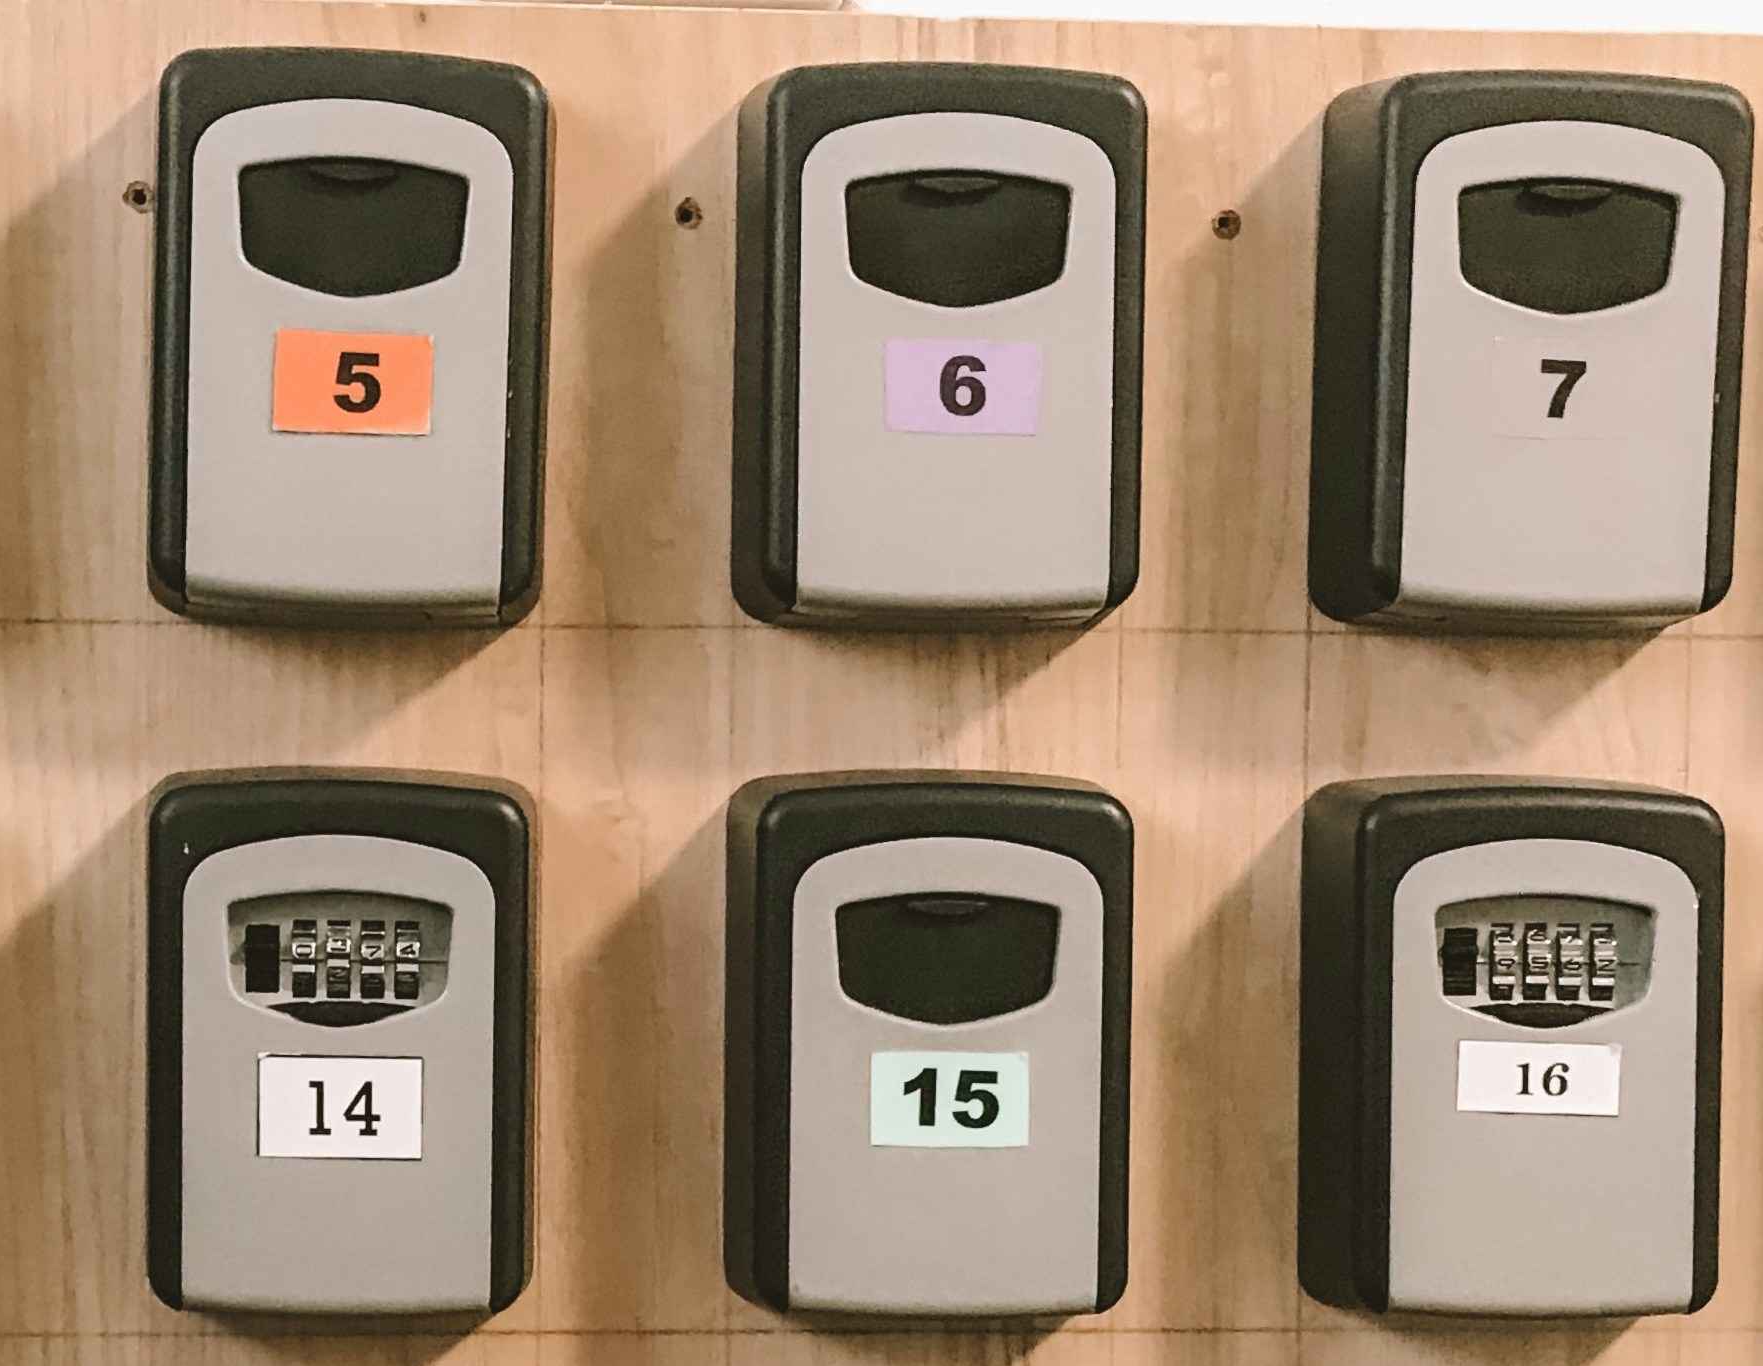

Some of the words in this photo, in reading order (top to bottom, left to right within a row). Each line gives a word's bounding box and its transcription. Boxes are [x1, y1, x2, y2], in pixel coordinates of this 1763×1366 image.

[333, 351, 382, 414] 5
[939, 355, 987, 417] 6
[1540, 358, 1587, 419] 7
[308, 1080, 381, 1137] 14
[903, 1067, 1000, 1129] 15
[1518, 1062, 1570, 1096] 16
